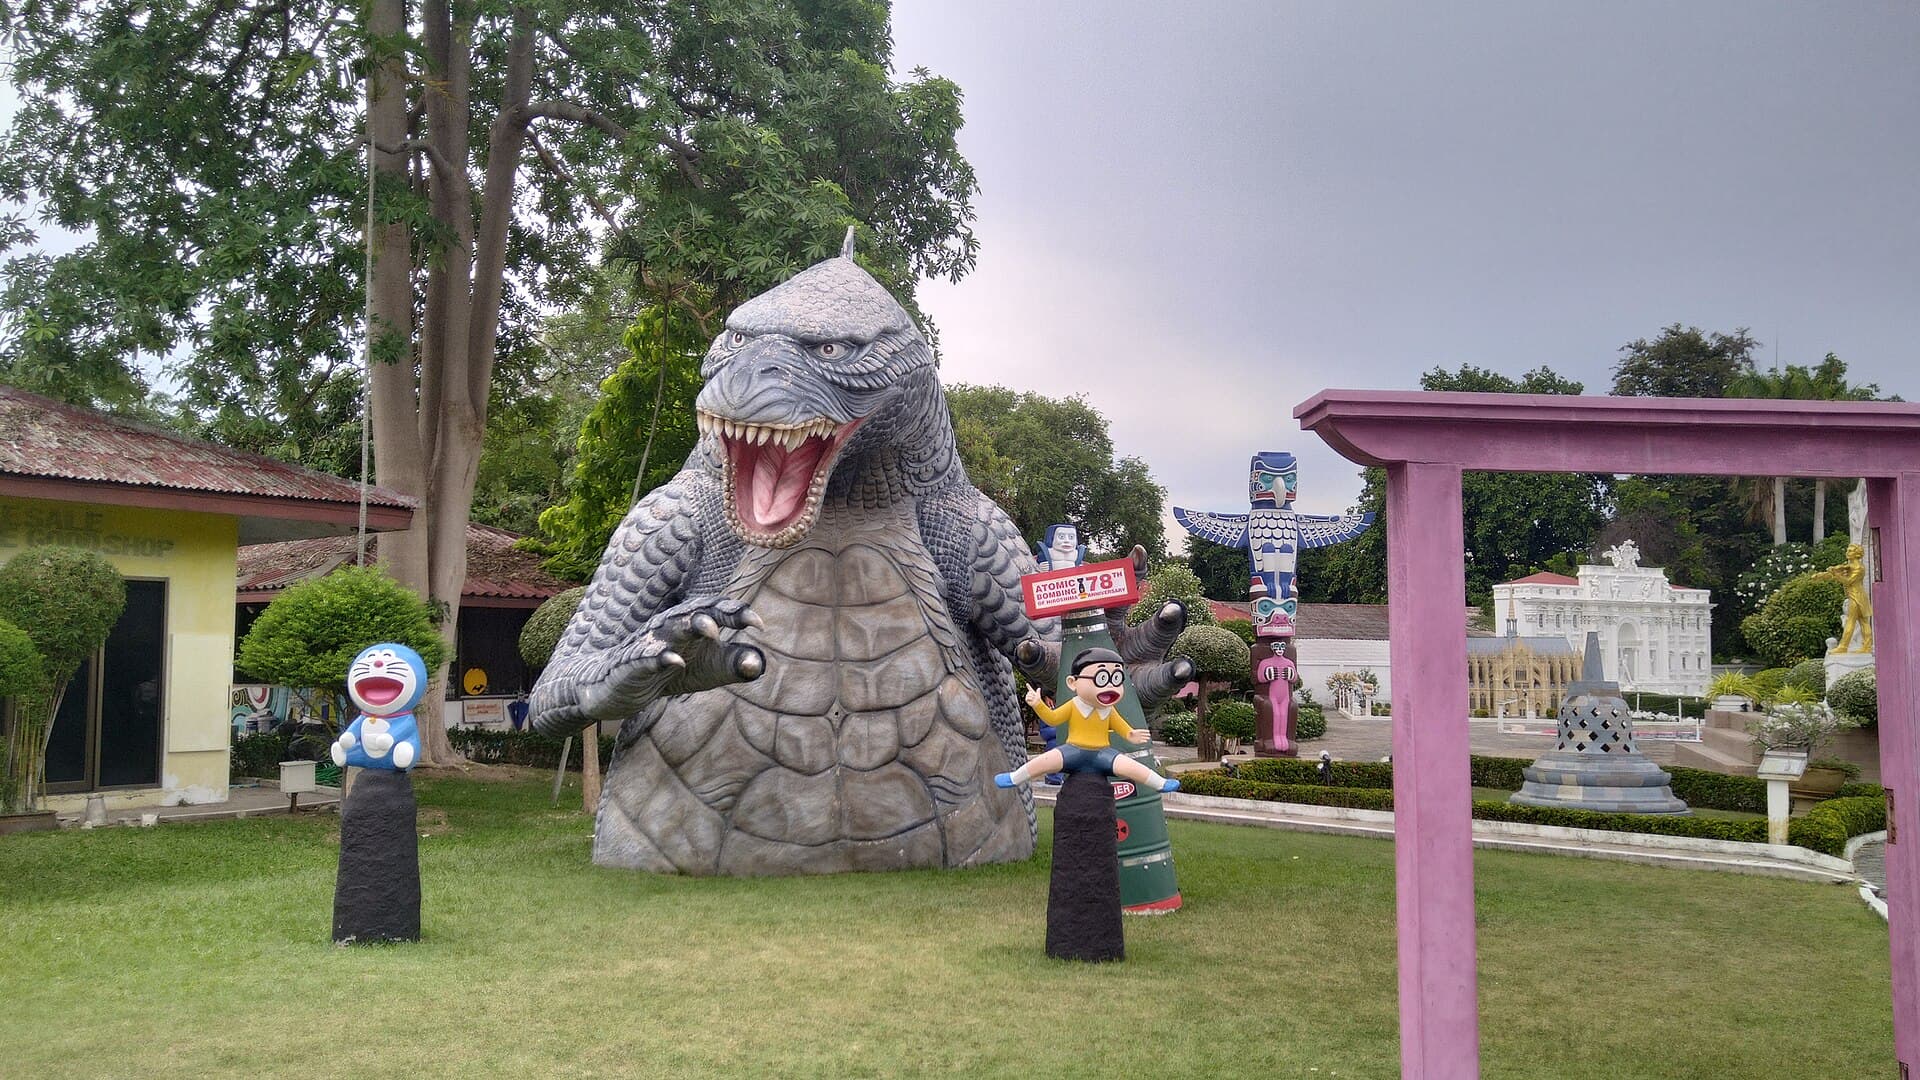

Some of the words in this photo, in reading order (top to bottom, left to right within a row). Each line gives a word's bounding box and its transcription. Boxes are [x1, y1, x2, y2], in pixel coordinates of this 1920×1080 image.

[103, 534, 174, 557] SHOP
[1035, 580, 1076, 593] ATOMIC
[1087, 587, 1126, 598] ANNIVERSARY
[1036, 587, 1077, 600] BOMBING
[1046, 595, 1078, 605] HIROSHIMA
